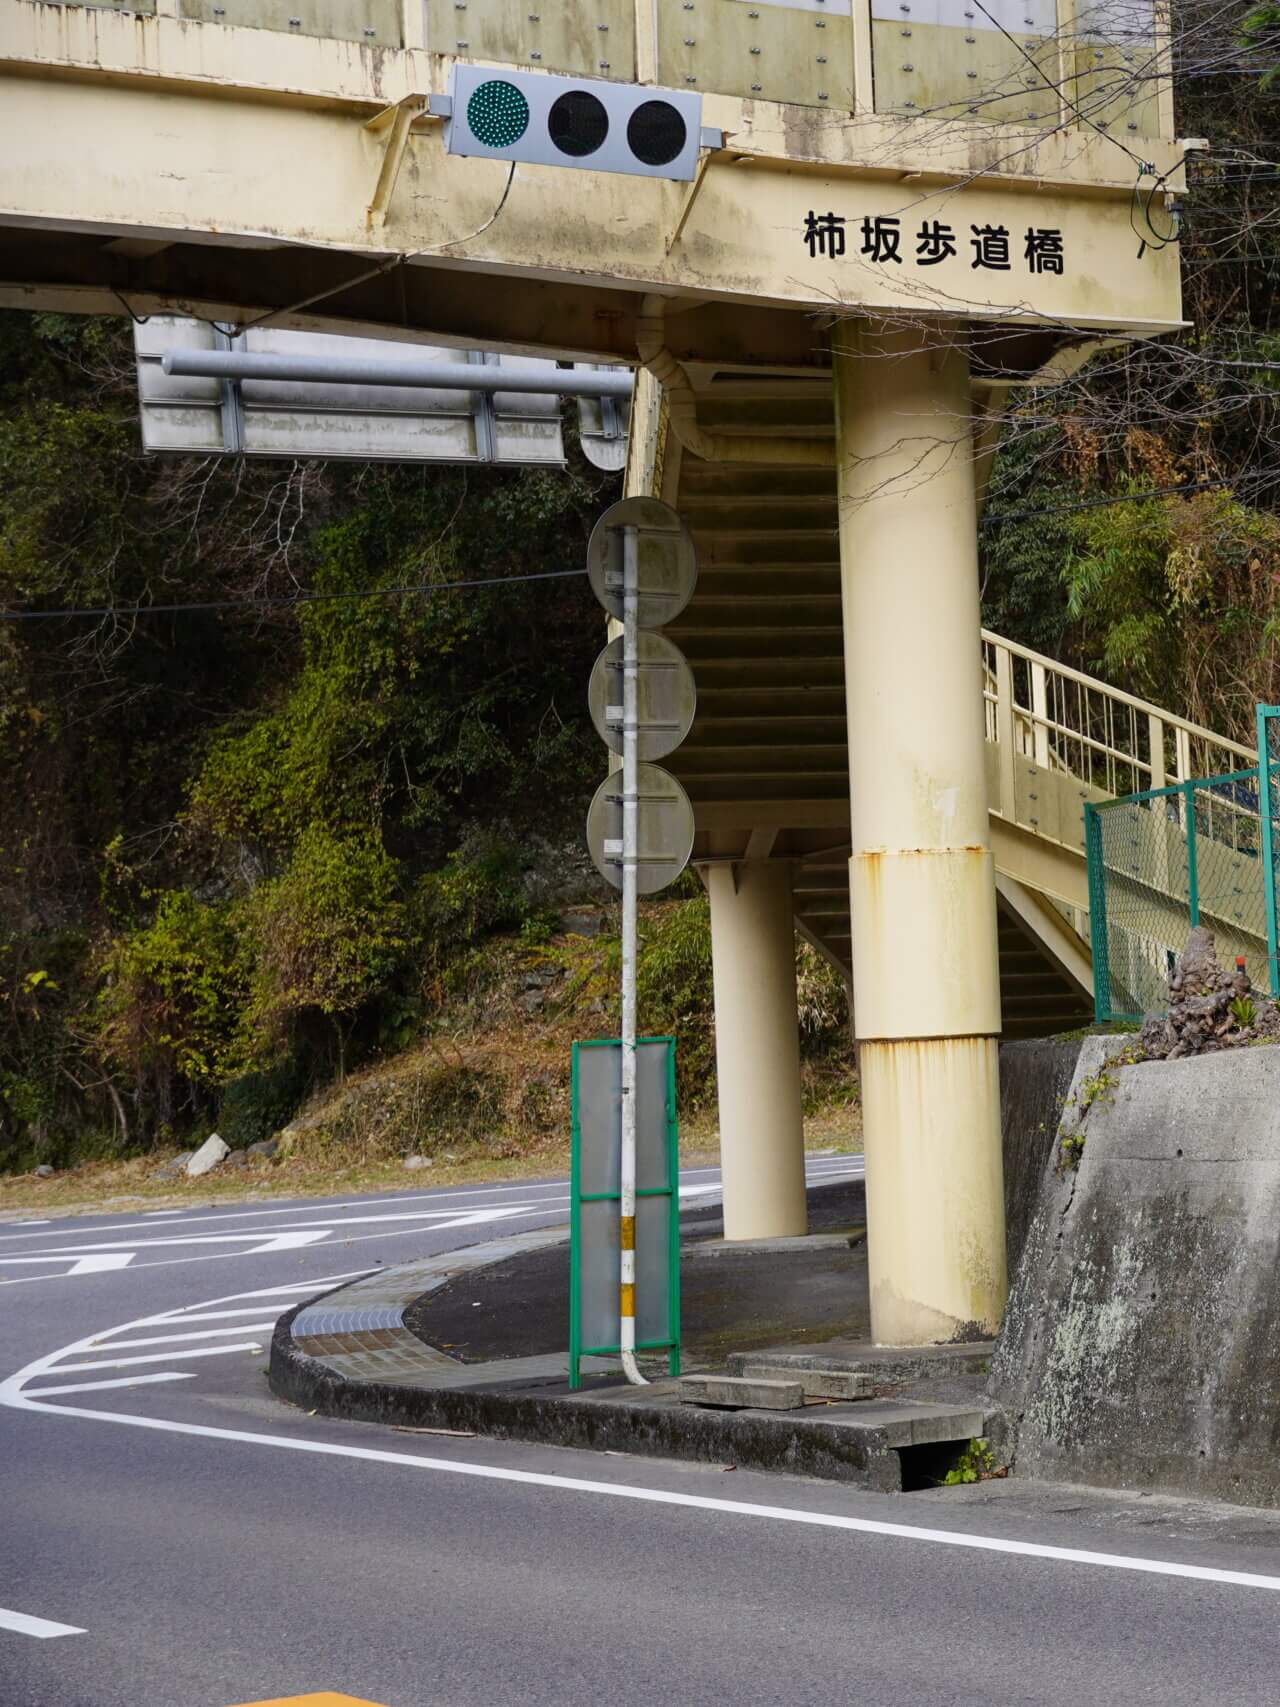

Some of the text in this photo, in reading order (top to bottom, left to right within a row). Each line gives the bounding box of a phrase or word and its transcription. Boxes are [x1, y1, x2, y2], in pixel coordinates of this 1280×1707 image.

[804, 210, 1064, 275] 柿坂歩道橋
